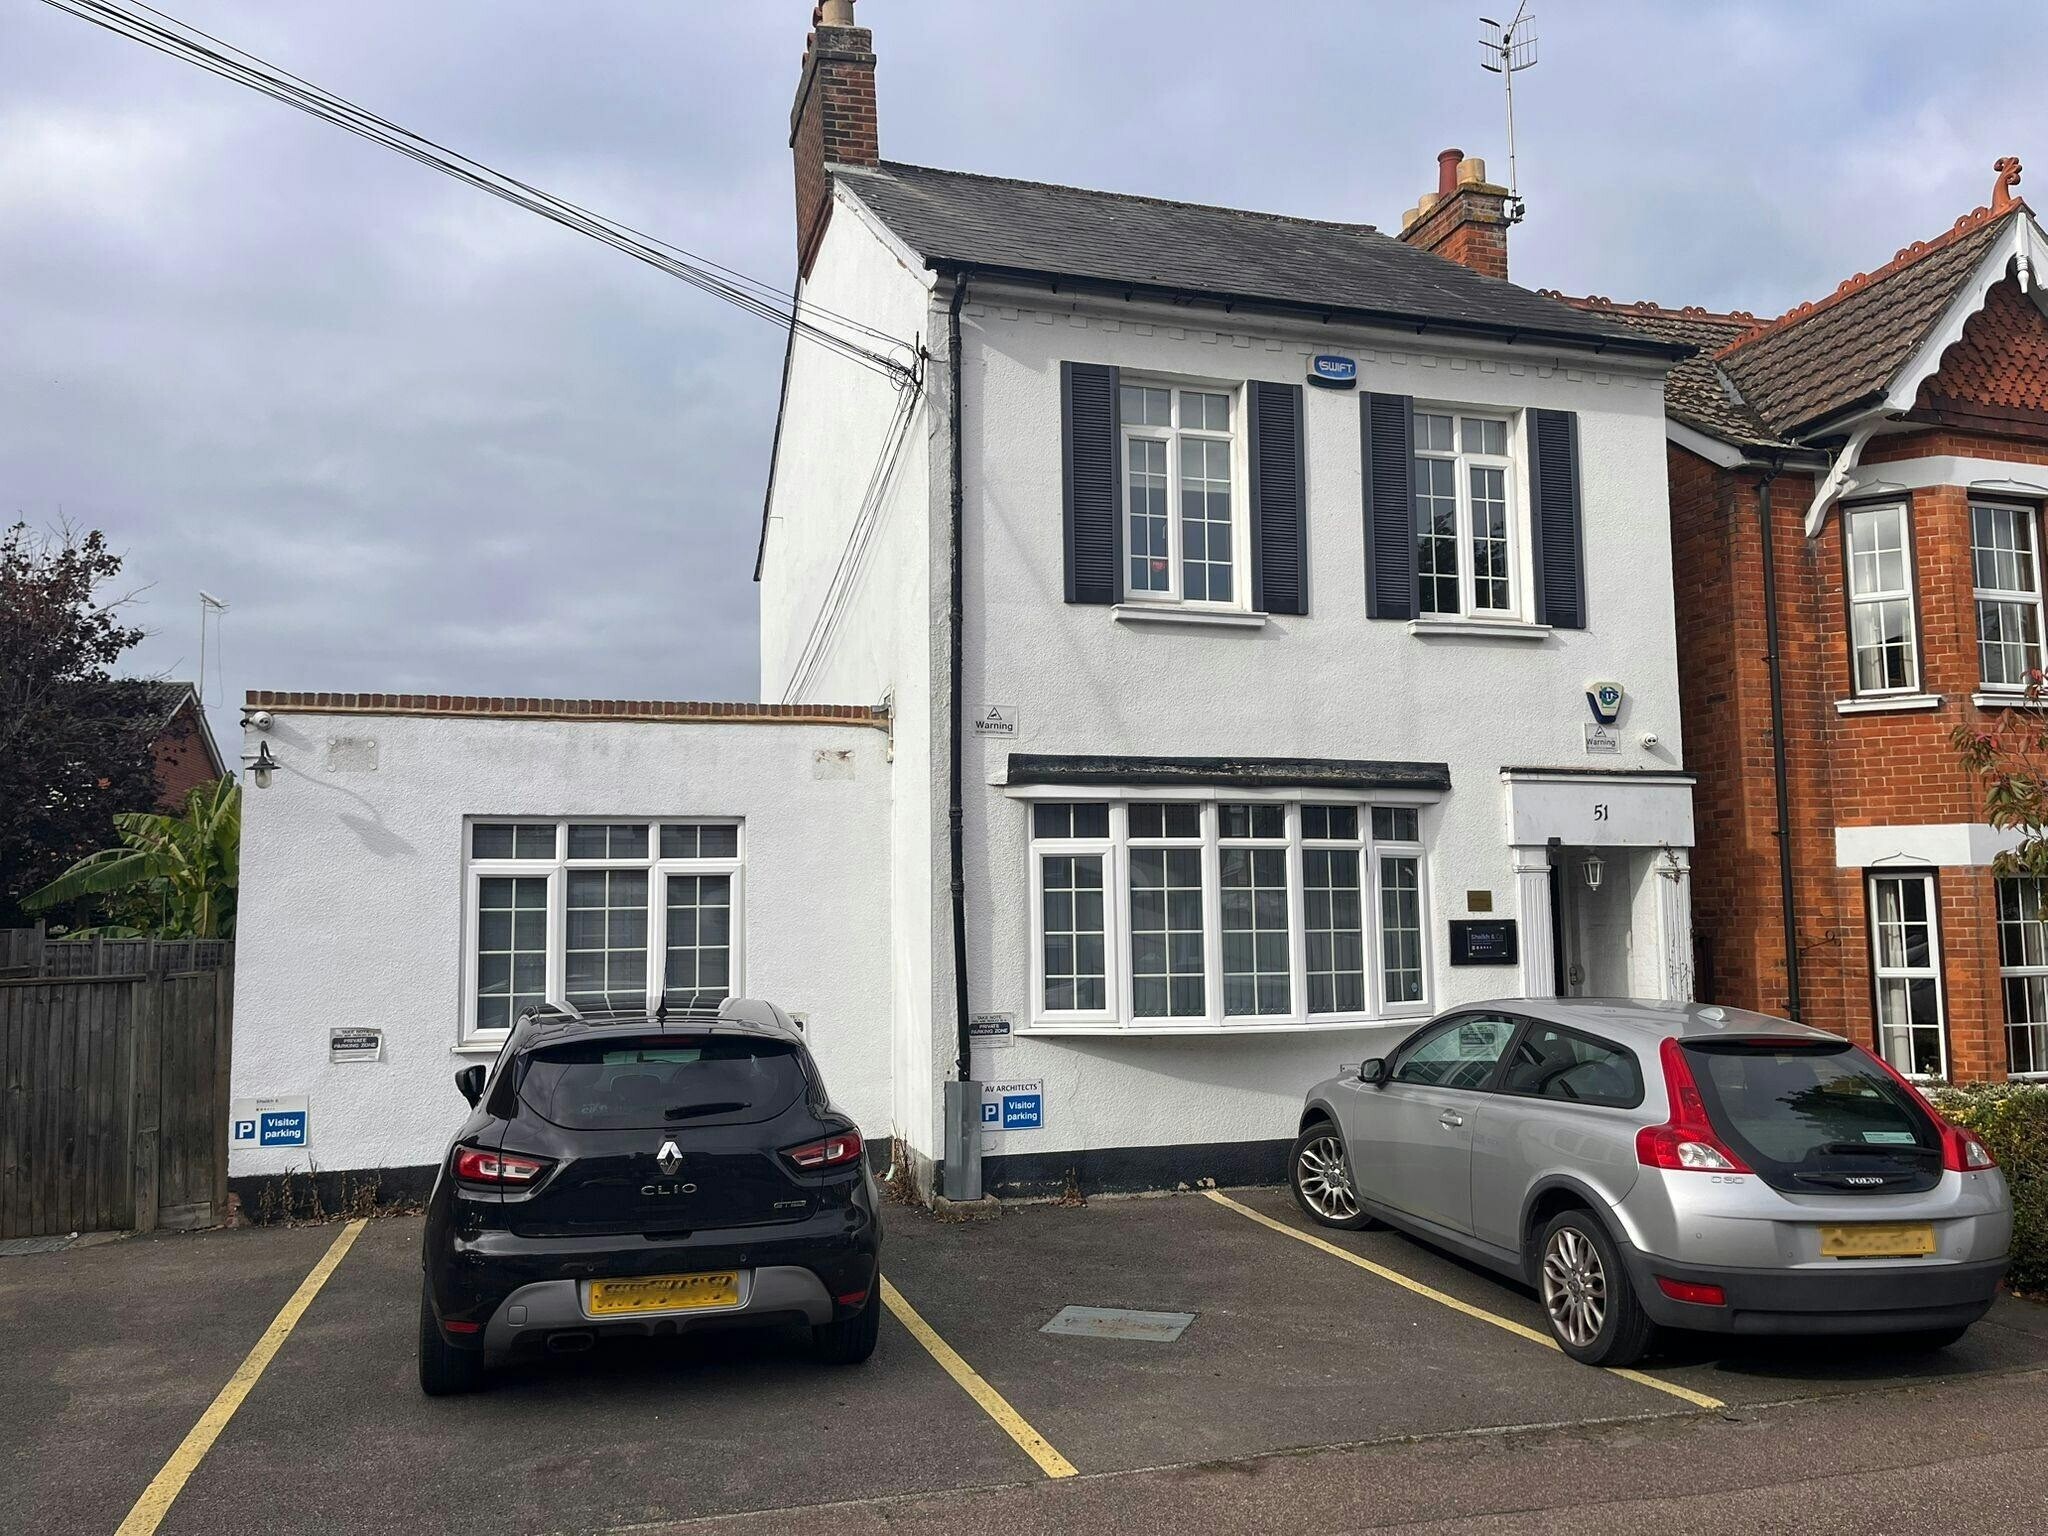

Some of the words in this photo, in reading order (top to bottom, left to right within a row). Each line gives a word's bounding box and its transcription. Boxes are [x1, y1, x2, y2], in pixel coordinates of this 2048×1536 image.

[1320, 360, 1353, 373] SWIFT
[1598, 690, 1620, 700] NTS
[975, 720, 1013, 731] Warning
[1585, 738, 1616, 747] Warning
[1594, 804, 1609, 821] 51
[996, 1083, 1038, 1092] ARCHITECTS
[1008, 1100, 1036, 1110] Visitor
[984, 1105, 997, 1121] P
[1007, 1112, 1038, 1123] parking
[267, 1118, 300, 1127] Visitor
[239, 1122, 253, 1139] P
[264, 1129, 301, 1140] parking
[1845, 1176, 1884, 1185] VOLVO
[641, 1183, 698, 1196] CLIO
